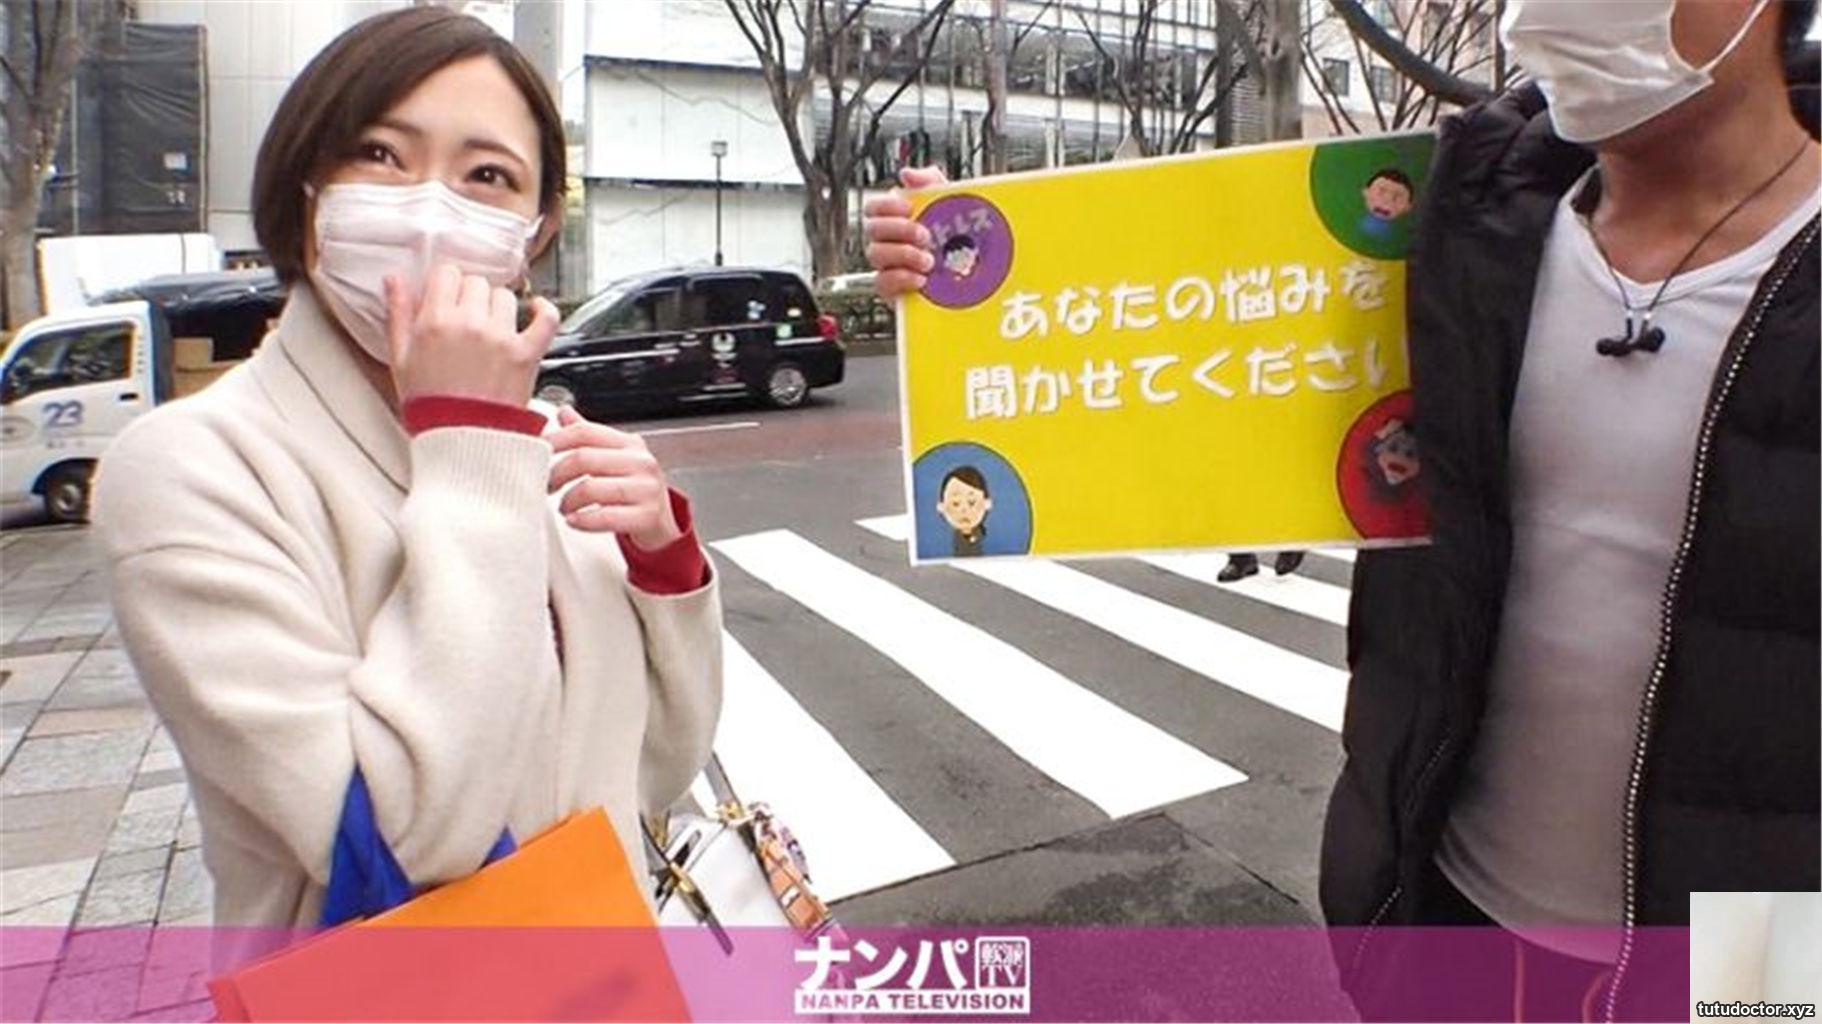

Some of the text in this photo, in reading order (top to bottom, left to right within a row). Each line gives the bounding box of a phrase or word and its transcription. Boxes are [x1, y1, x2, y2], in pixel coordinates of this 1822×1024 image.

[1000, 261, 1388, 341] あなたの悩みを
[43, 400, 83, 427] 23
